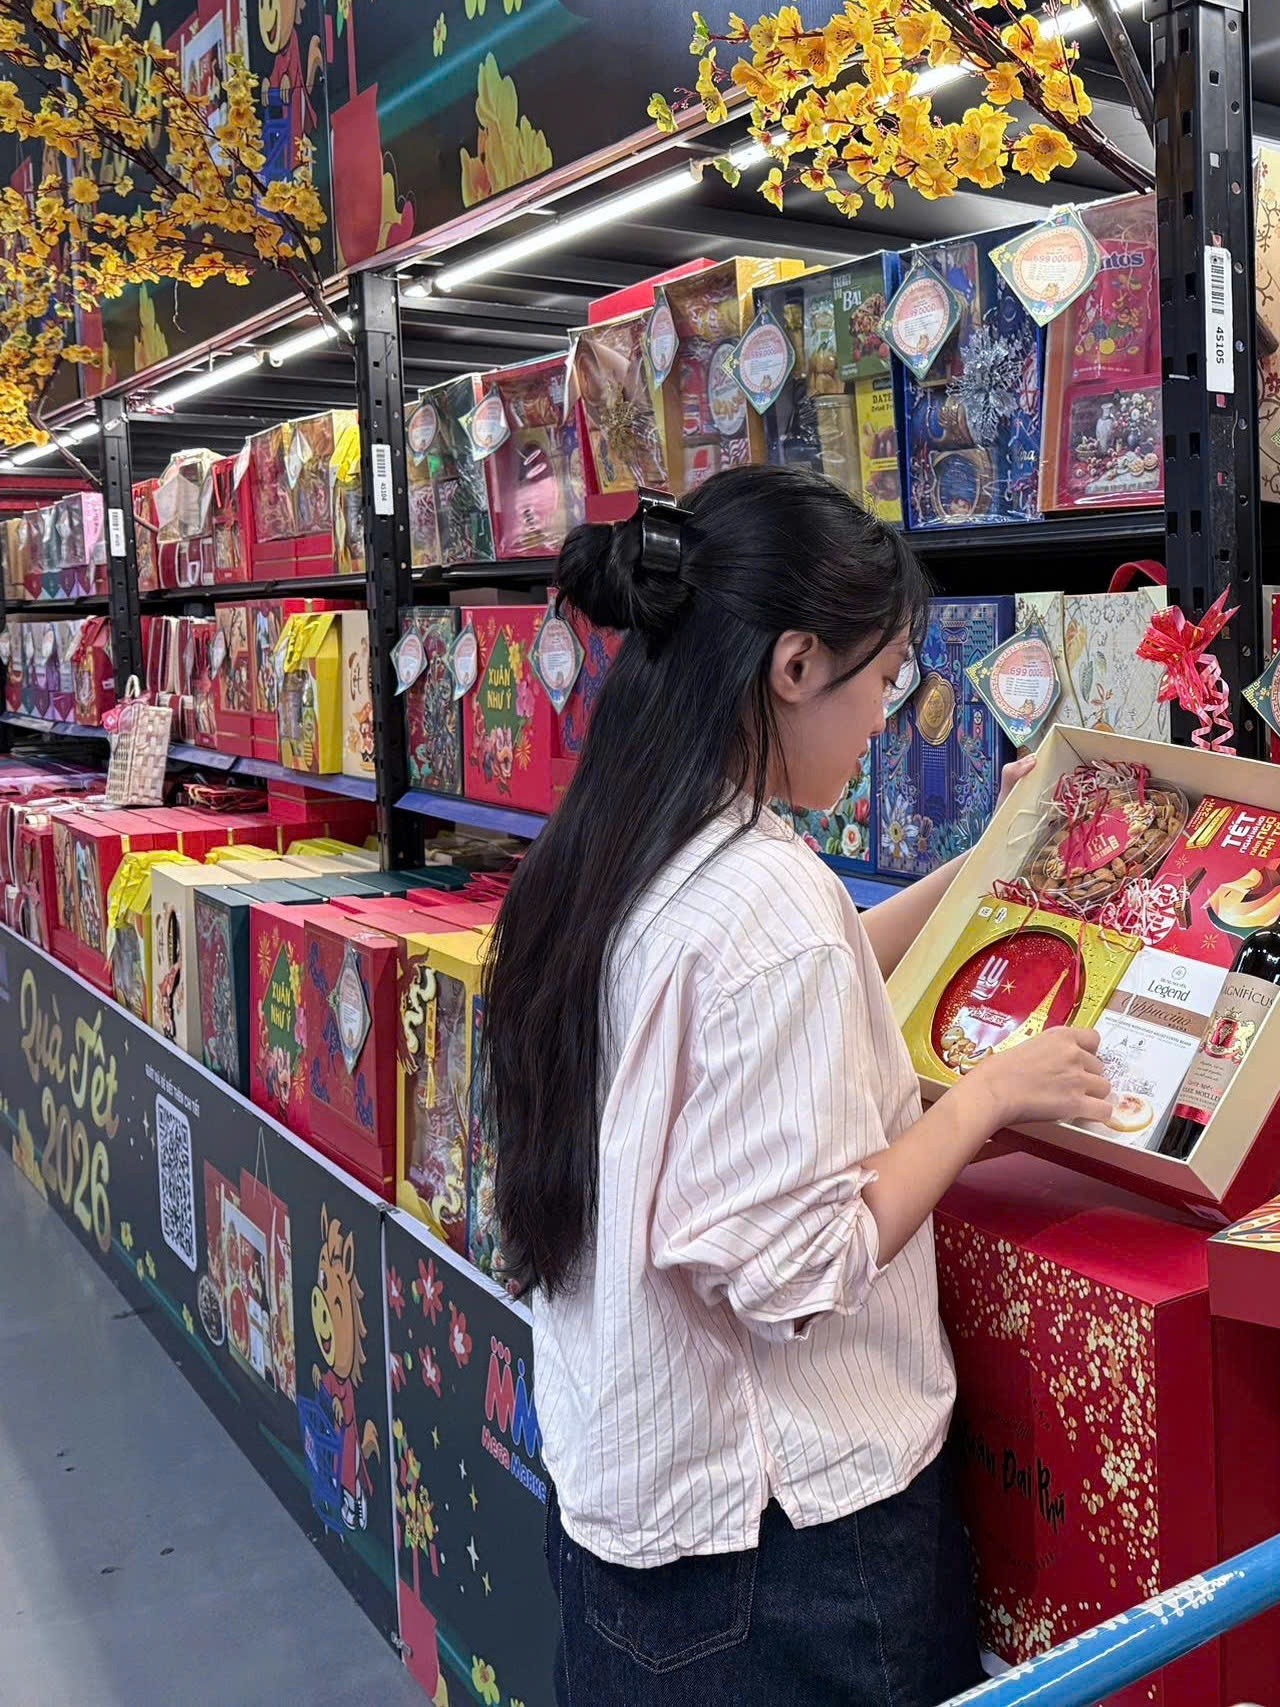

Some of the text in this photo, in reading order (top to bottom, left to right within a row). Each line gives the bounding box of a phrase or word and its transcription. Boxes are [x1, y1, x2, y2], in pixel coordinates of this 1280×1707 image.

[1101, 252, 1145, 270] ntos
[1215, 326, 1225, 364] 45105
[872, 392, 893, 404] DATE
[488, 663, 511, 687] XUÂN
[1221, 811, 1256, 848] TẾT
[271, 981, 291, 1011] XUÂN
[1147, 979, 1191, 1002] Legend
[20, 967, 66, 1084] Quà
[1121, 995, 1192, 1027] Cppuccino
[69, 1009, 120, 1138] Tết
[42, 1086, 112, 1252] 2026
